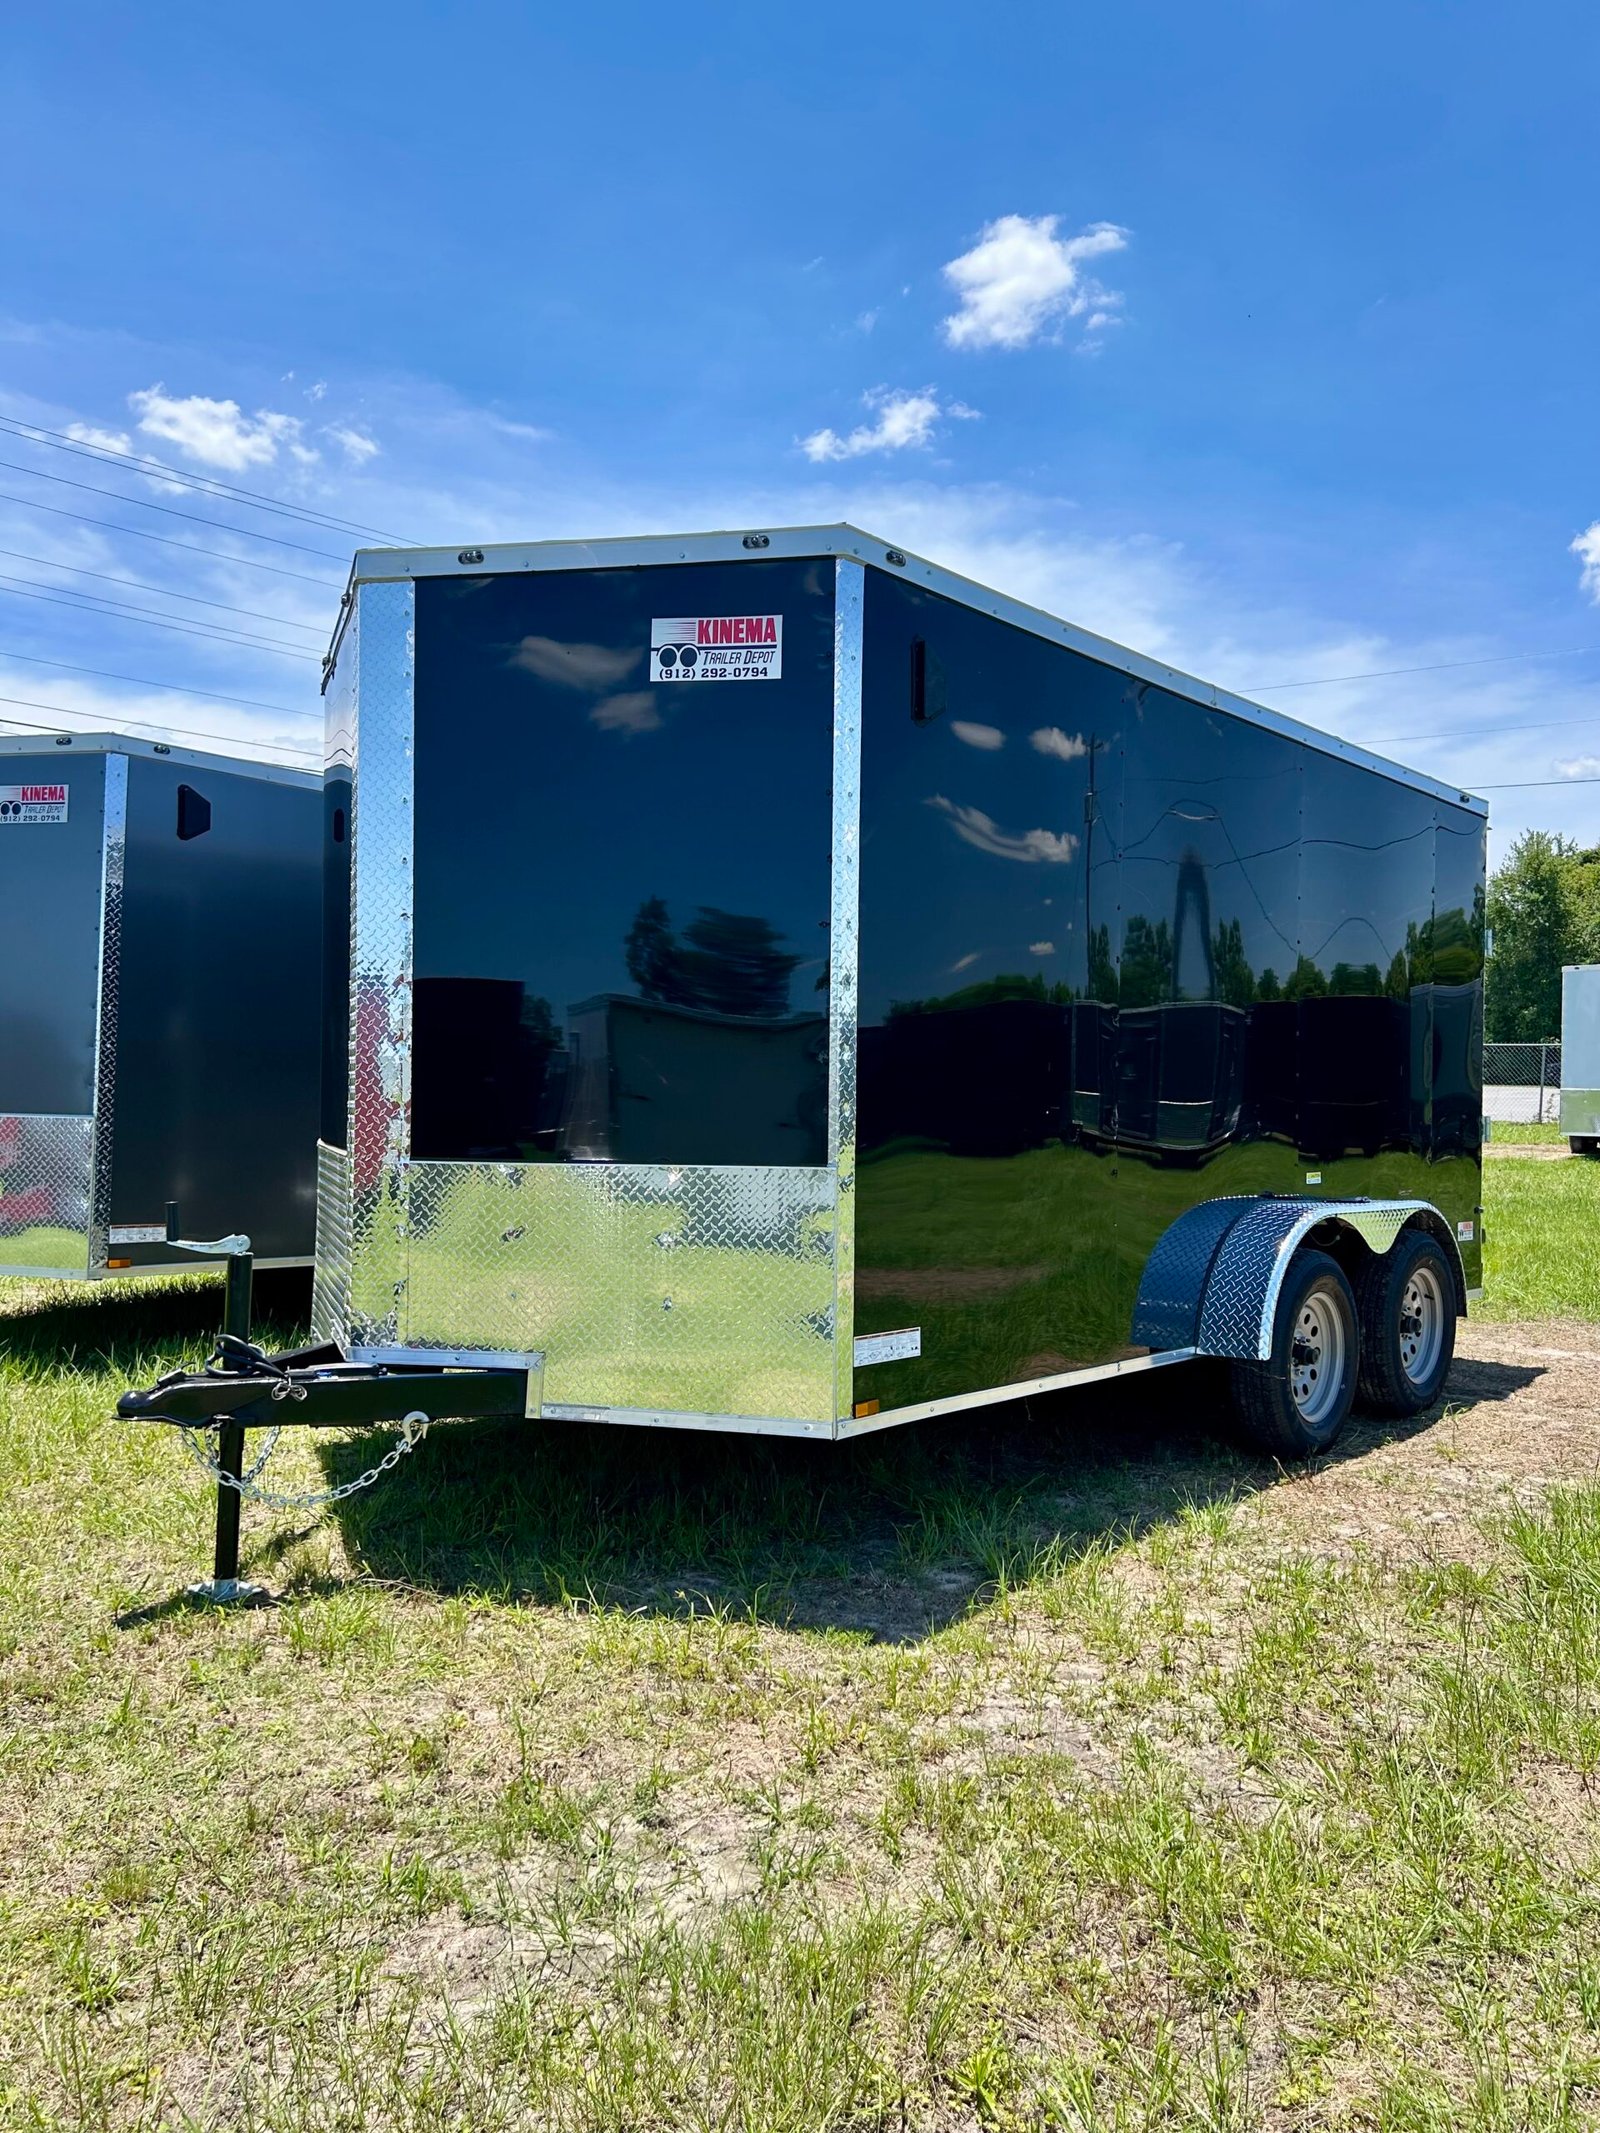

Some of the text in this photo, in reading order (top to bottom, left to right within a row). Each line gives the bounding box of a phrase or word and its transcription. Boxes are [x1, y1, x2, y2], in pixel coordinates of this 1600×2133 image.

[697, 617, 777, 644] KINEMA
[659, 667, 768, 680] (912) 292-0794
[21, 786, 65, 801] KINEMA
[1, 815, 21, 823] (912)
